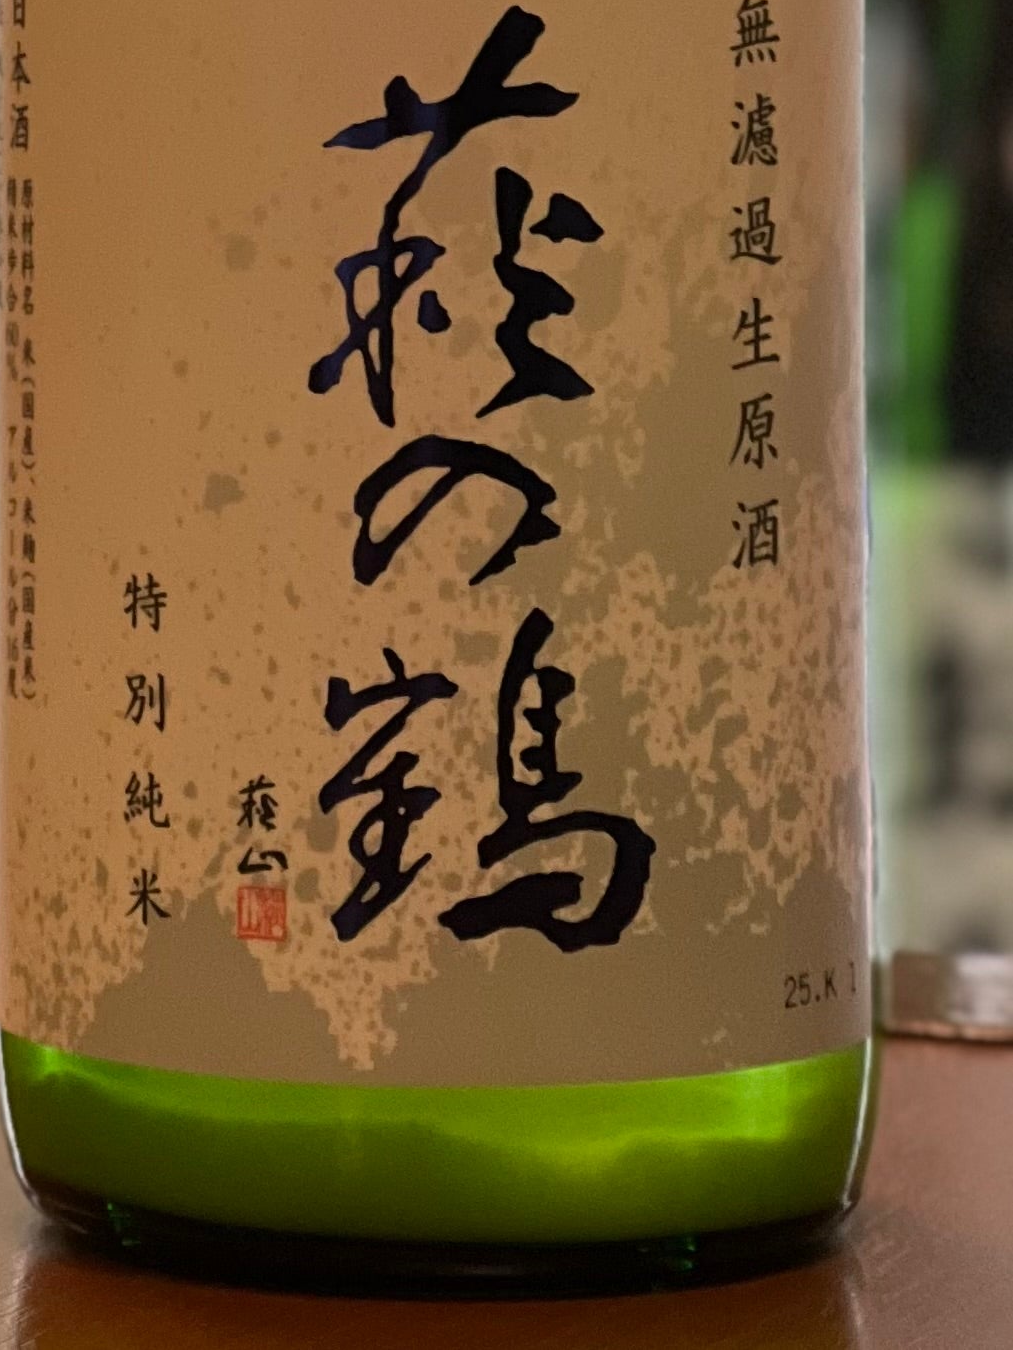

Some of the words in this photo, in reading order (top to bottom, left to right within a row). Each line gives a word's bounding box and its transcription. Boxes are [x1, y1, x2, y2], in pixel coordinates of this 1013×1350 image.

[123, 572, 172, 927] 特別純米
[308, 6, 658, 954] 萩の鶴
